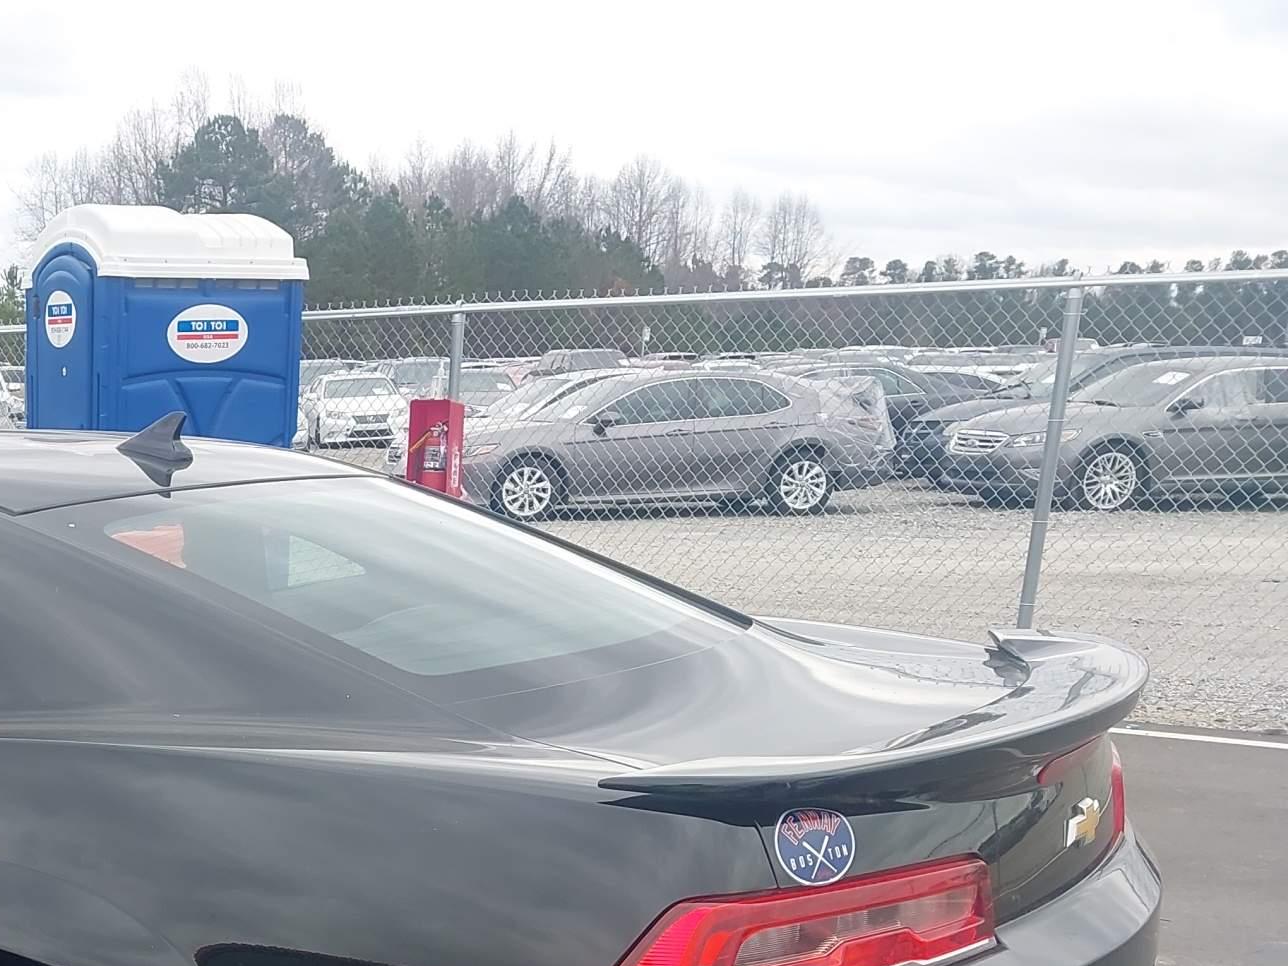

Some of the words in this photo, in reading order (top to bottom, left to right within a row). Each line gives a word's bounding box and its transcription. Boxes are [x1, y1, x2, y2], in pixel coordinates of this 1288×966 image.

[190, 321, 207, 331] TOI
[210, 321, 227, 330] TOI
[781, 811, 841, 846] FENWAY
